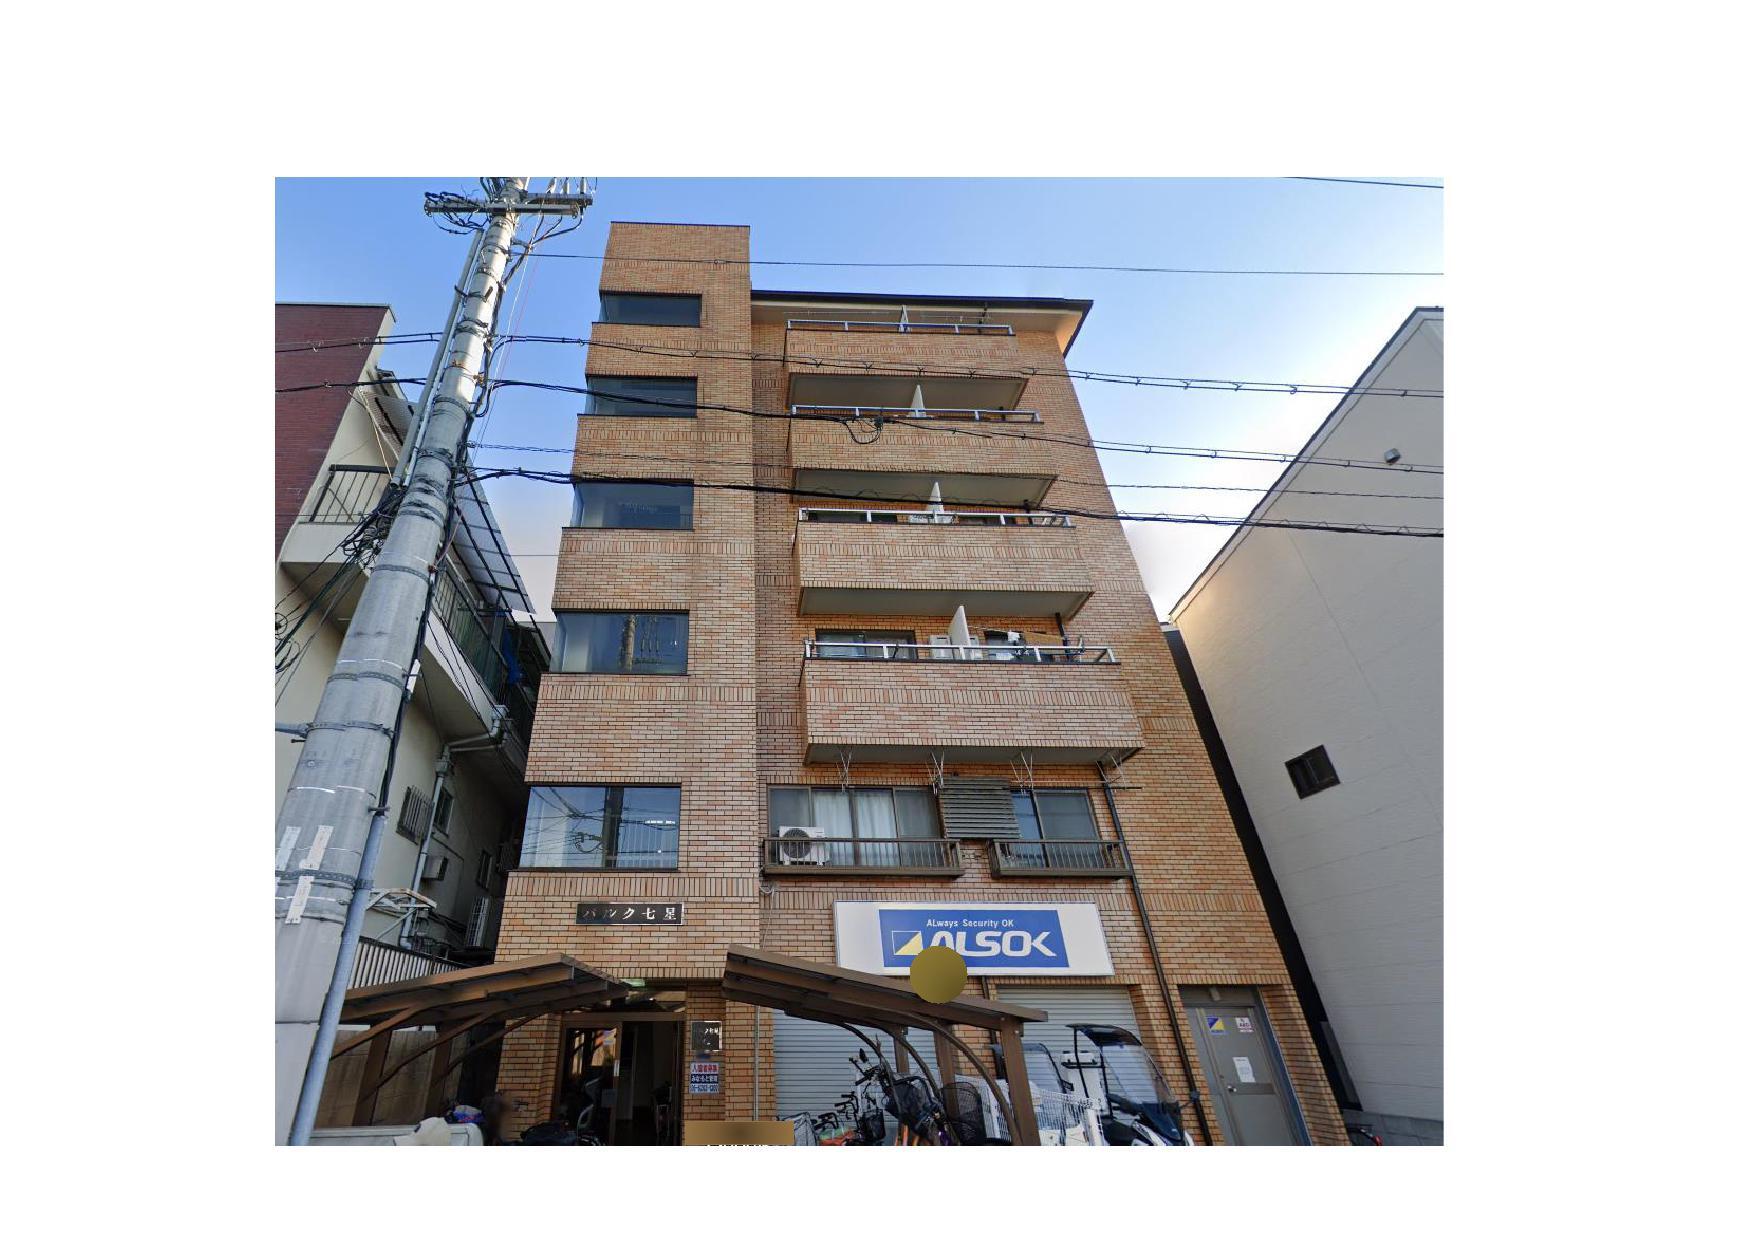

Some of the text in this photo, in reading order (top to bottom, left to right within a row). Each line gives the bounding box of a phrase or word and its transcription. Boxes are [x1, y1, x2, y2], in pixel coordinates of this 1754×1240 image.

[926, 918, 1015, 929] ALways Security OK
